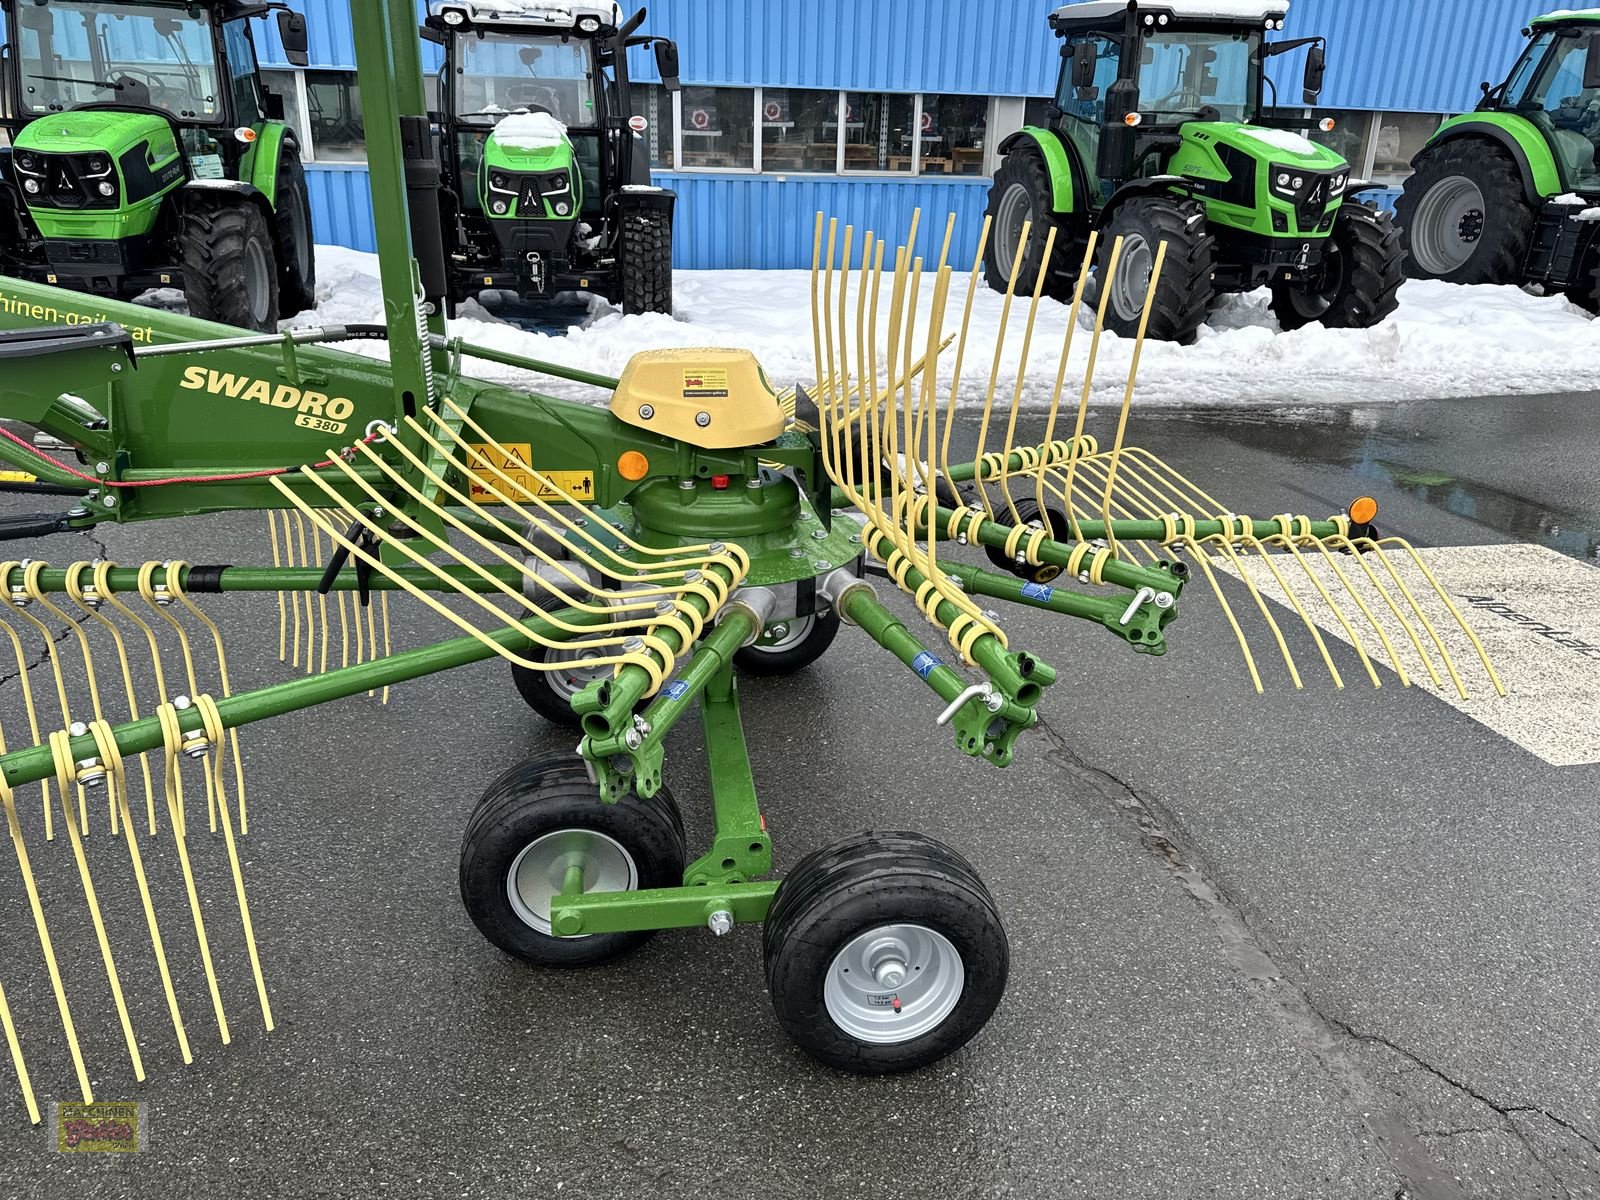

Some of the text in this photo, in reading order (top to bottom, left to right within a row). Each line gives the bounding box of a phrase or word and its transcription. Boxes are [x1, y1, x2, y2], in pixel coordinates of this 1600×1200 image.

[180, 366, 355, 420] SWADRO
[301, 417, 340, 433] S 380
